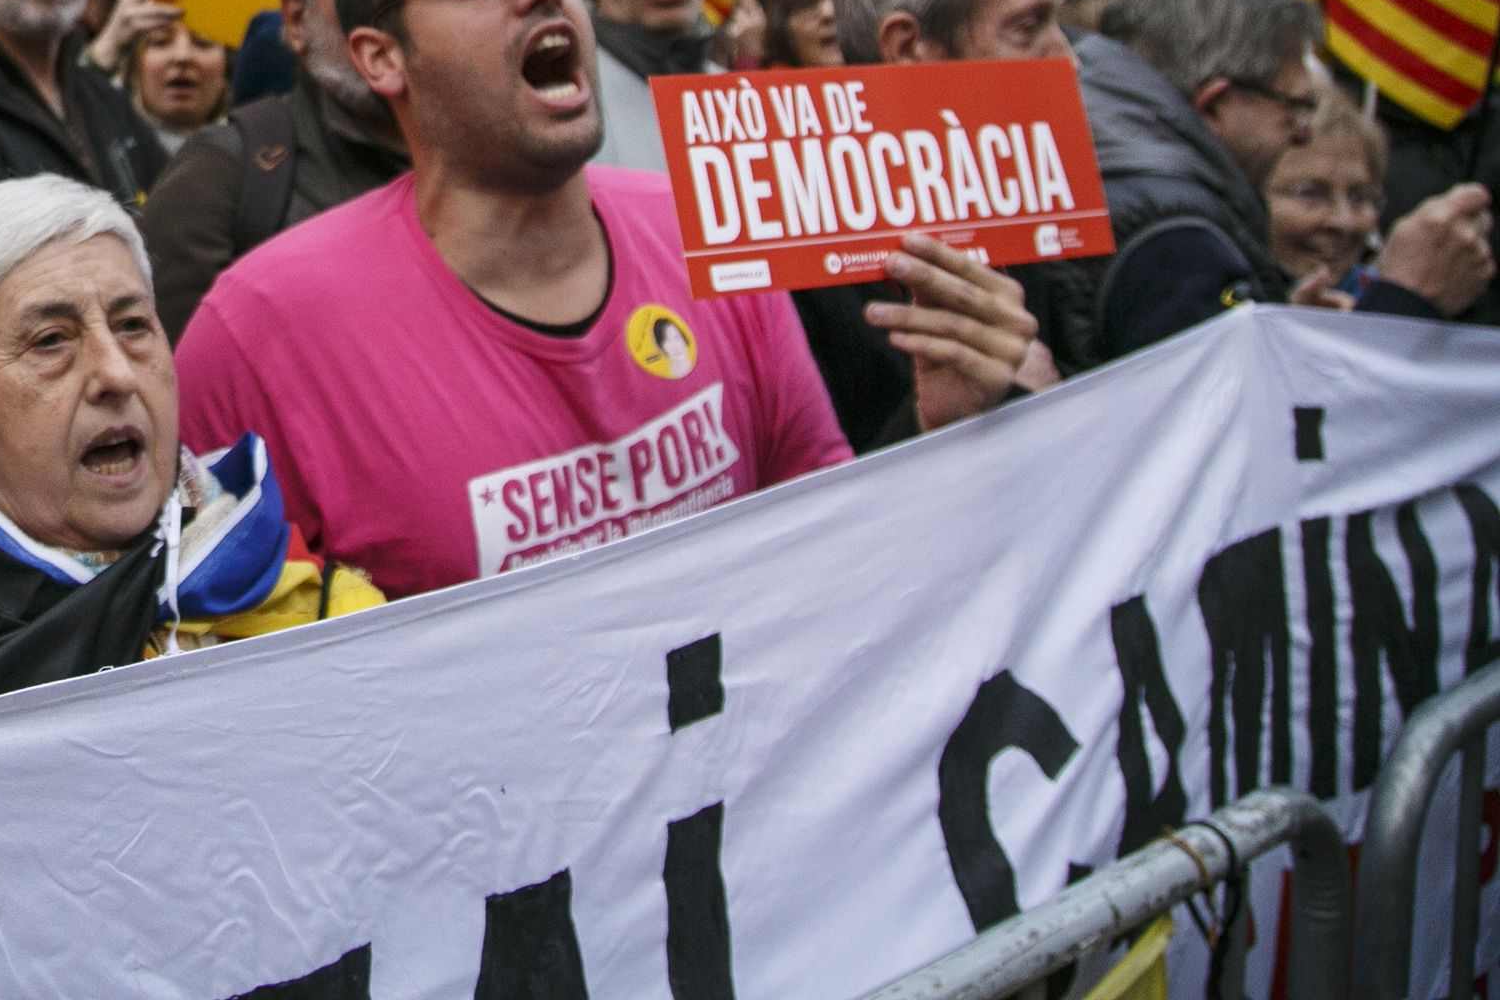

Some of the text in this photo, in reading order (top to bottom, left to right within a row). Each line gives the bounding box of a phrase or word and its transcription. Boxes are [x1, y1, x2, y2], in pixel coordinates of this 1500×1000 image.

[682, 78, 874, 145] AIXÒ VA DE
[688, 109, 1077, 246] DEMOCRÀCIA
[502, 401, 728, 544] SENSE POR!
